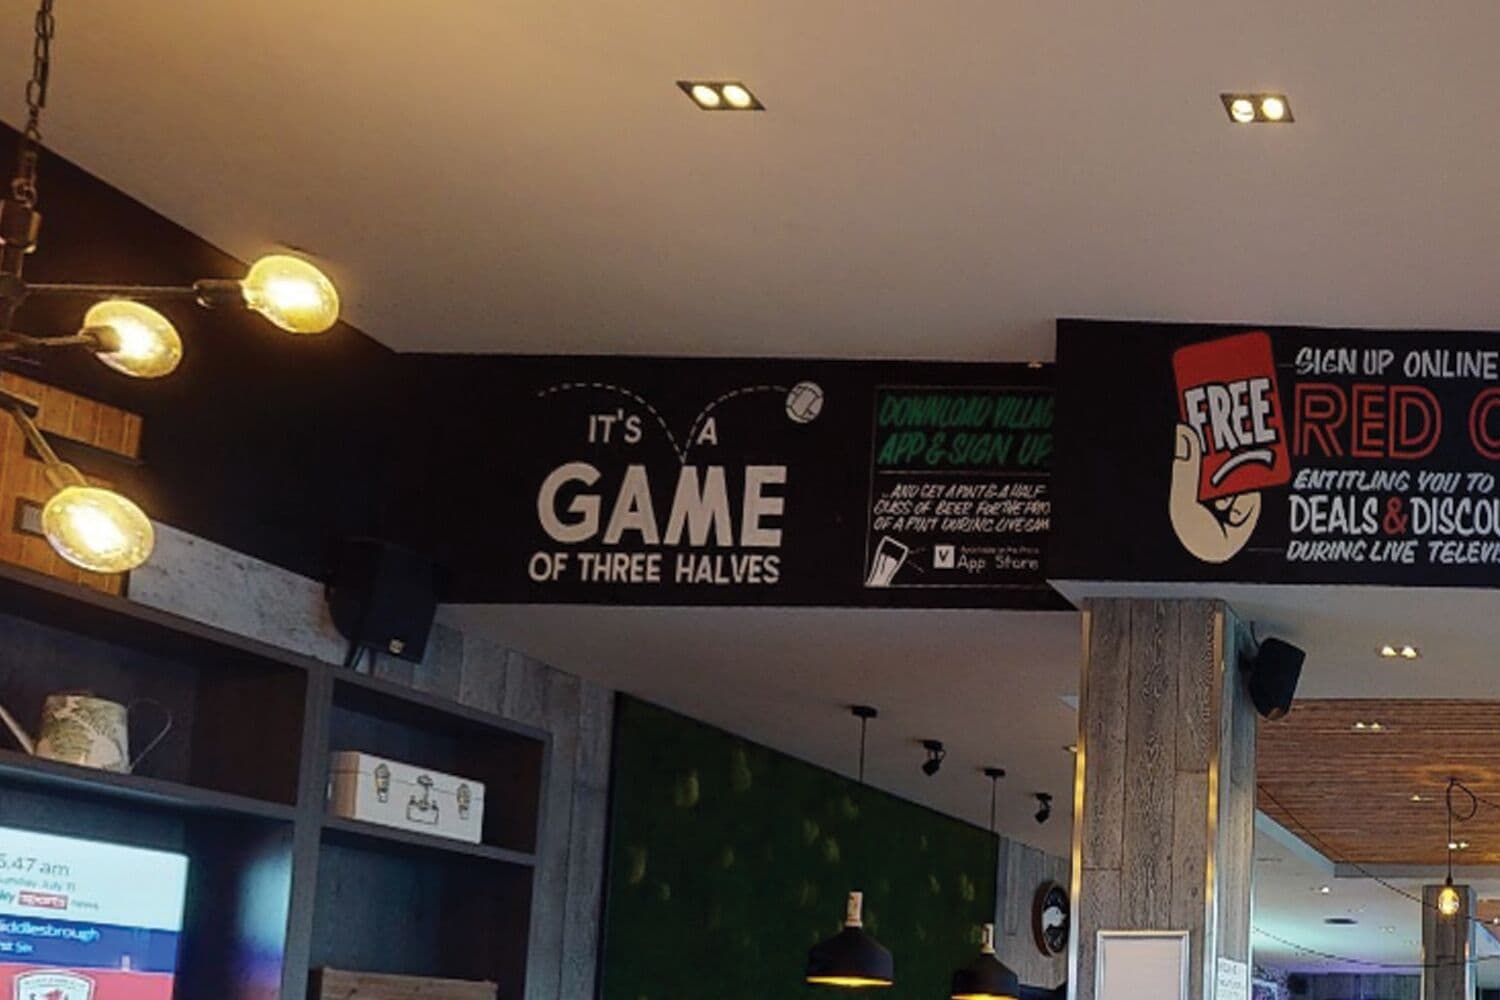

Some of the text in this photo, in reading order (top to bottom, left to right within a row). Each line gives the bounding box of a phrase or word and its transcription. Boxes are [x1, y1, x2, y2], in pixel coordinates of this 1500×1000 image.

[1295, 347, 1357, 375] SIGN
[1363, 350, 1395, 375] UP
[1403, 350, 1498, 379] ONLINE
[879, 395, 993, 427] DOWNLOAD
[1184, 378, 1276, 452] FREE
[1292, 382, 1442, 460] RED
[588, 408, 718, 445] IT'S A
[877, 432, 1053, 465] APP & SIGN UP
[920, 484, 946, 499] GET
[1009, 483, 1047, 499] HALF
[1292, 468, 1409, 491] ENTITLING
[1417, 470, 1461, 494] YOU
[1465, 472, 1495, 494] TO
[537, 461, 788, 547] GAME
[913, 501, 931, 515] OF
[935, 500, 973, 516] BEER
[1288, 494, 1378, 535] DEALS
[1382, 497, 1407, 535] &
[873, 516, 894, 531] OF
[892, 516, 905, 531] A
[957, 554, 1039, 574] App Store
[1286, 540, 1366, 563] DURING
[1368, 540, 1418, 563] LIVE
[529, 553, 781, 583] OF THREE HALVES
[40, 863, 70, 876] am
[0, 920, 101, 943] iddlesbrough
